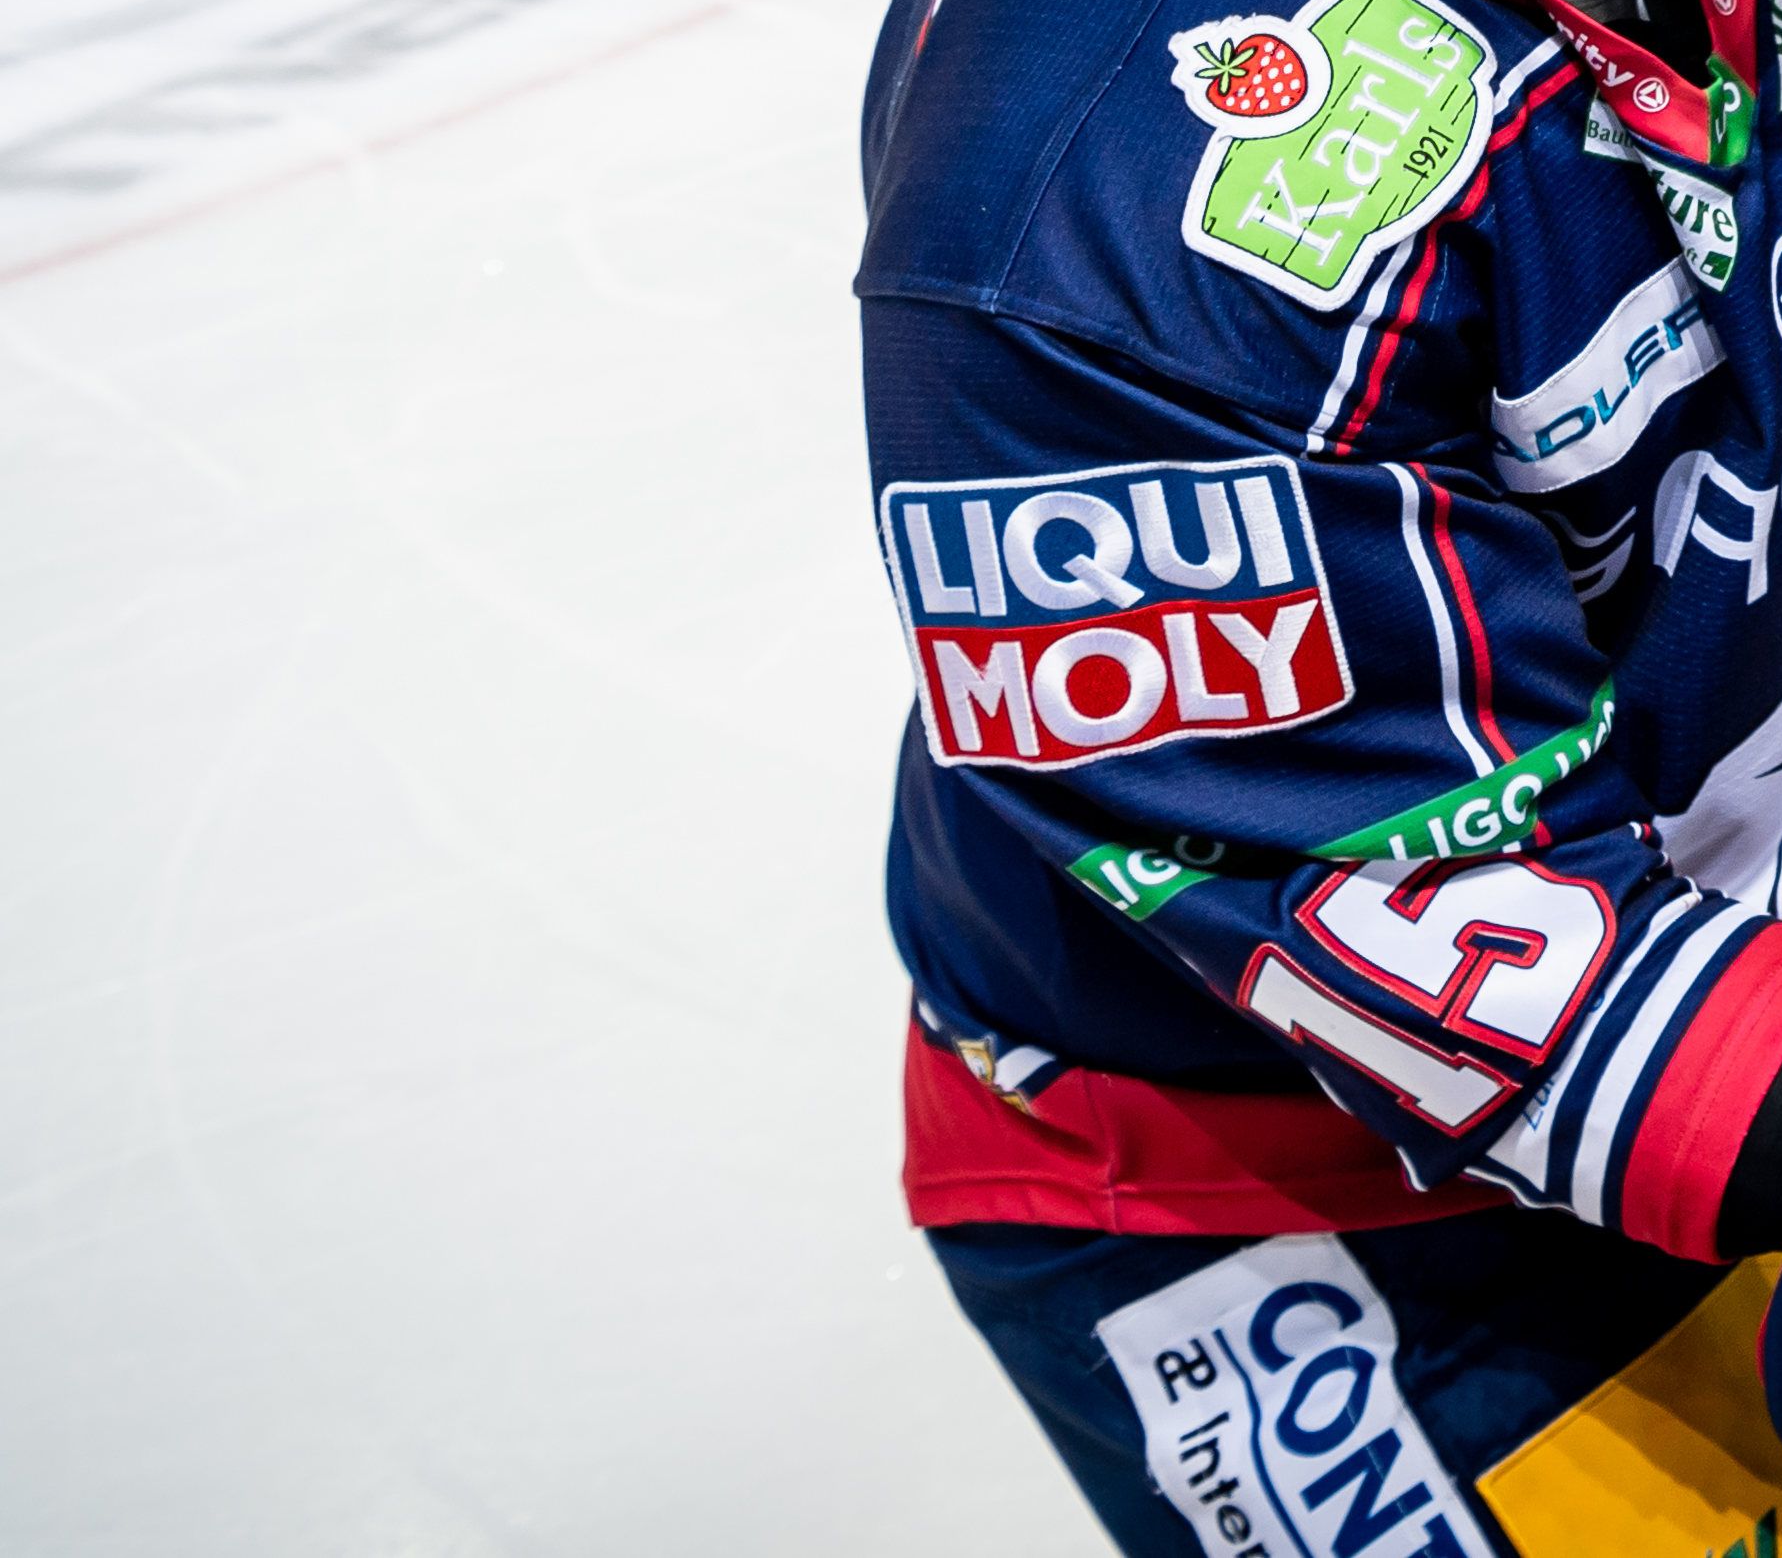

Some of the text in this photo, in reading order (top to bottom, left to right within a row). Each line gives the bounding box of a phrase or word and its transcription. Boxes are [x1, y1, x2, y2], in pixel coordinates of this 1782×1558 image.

[1234, 12, 1464, 268] Karls
[1401, 125, 1457, 181] 1921
[902, 475, 1296, 619] LIQUI
[930, 597, 1321, 758] MOLY
[1240, 847, 1618, 1138] 15
